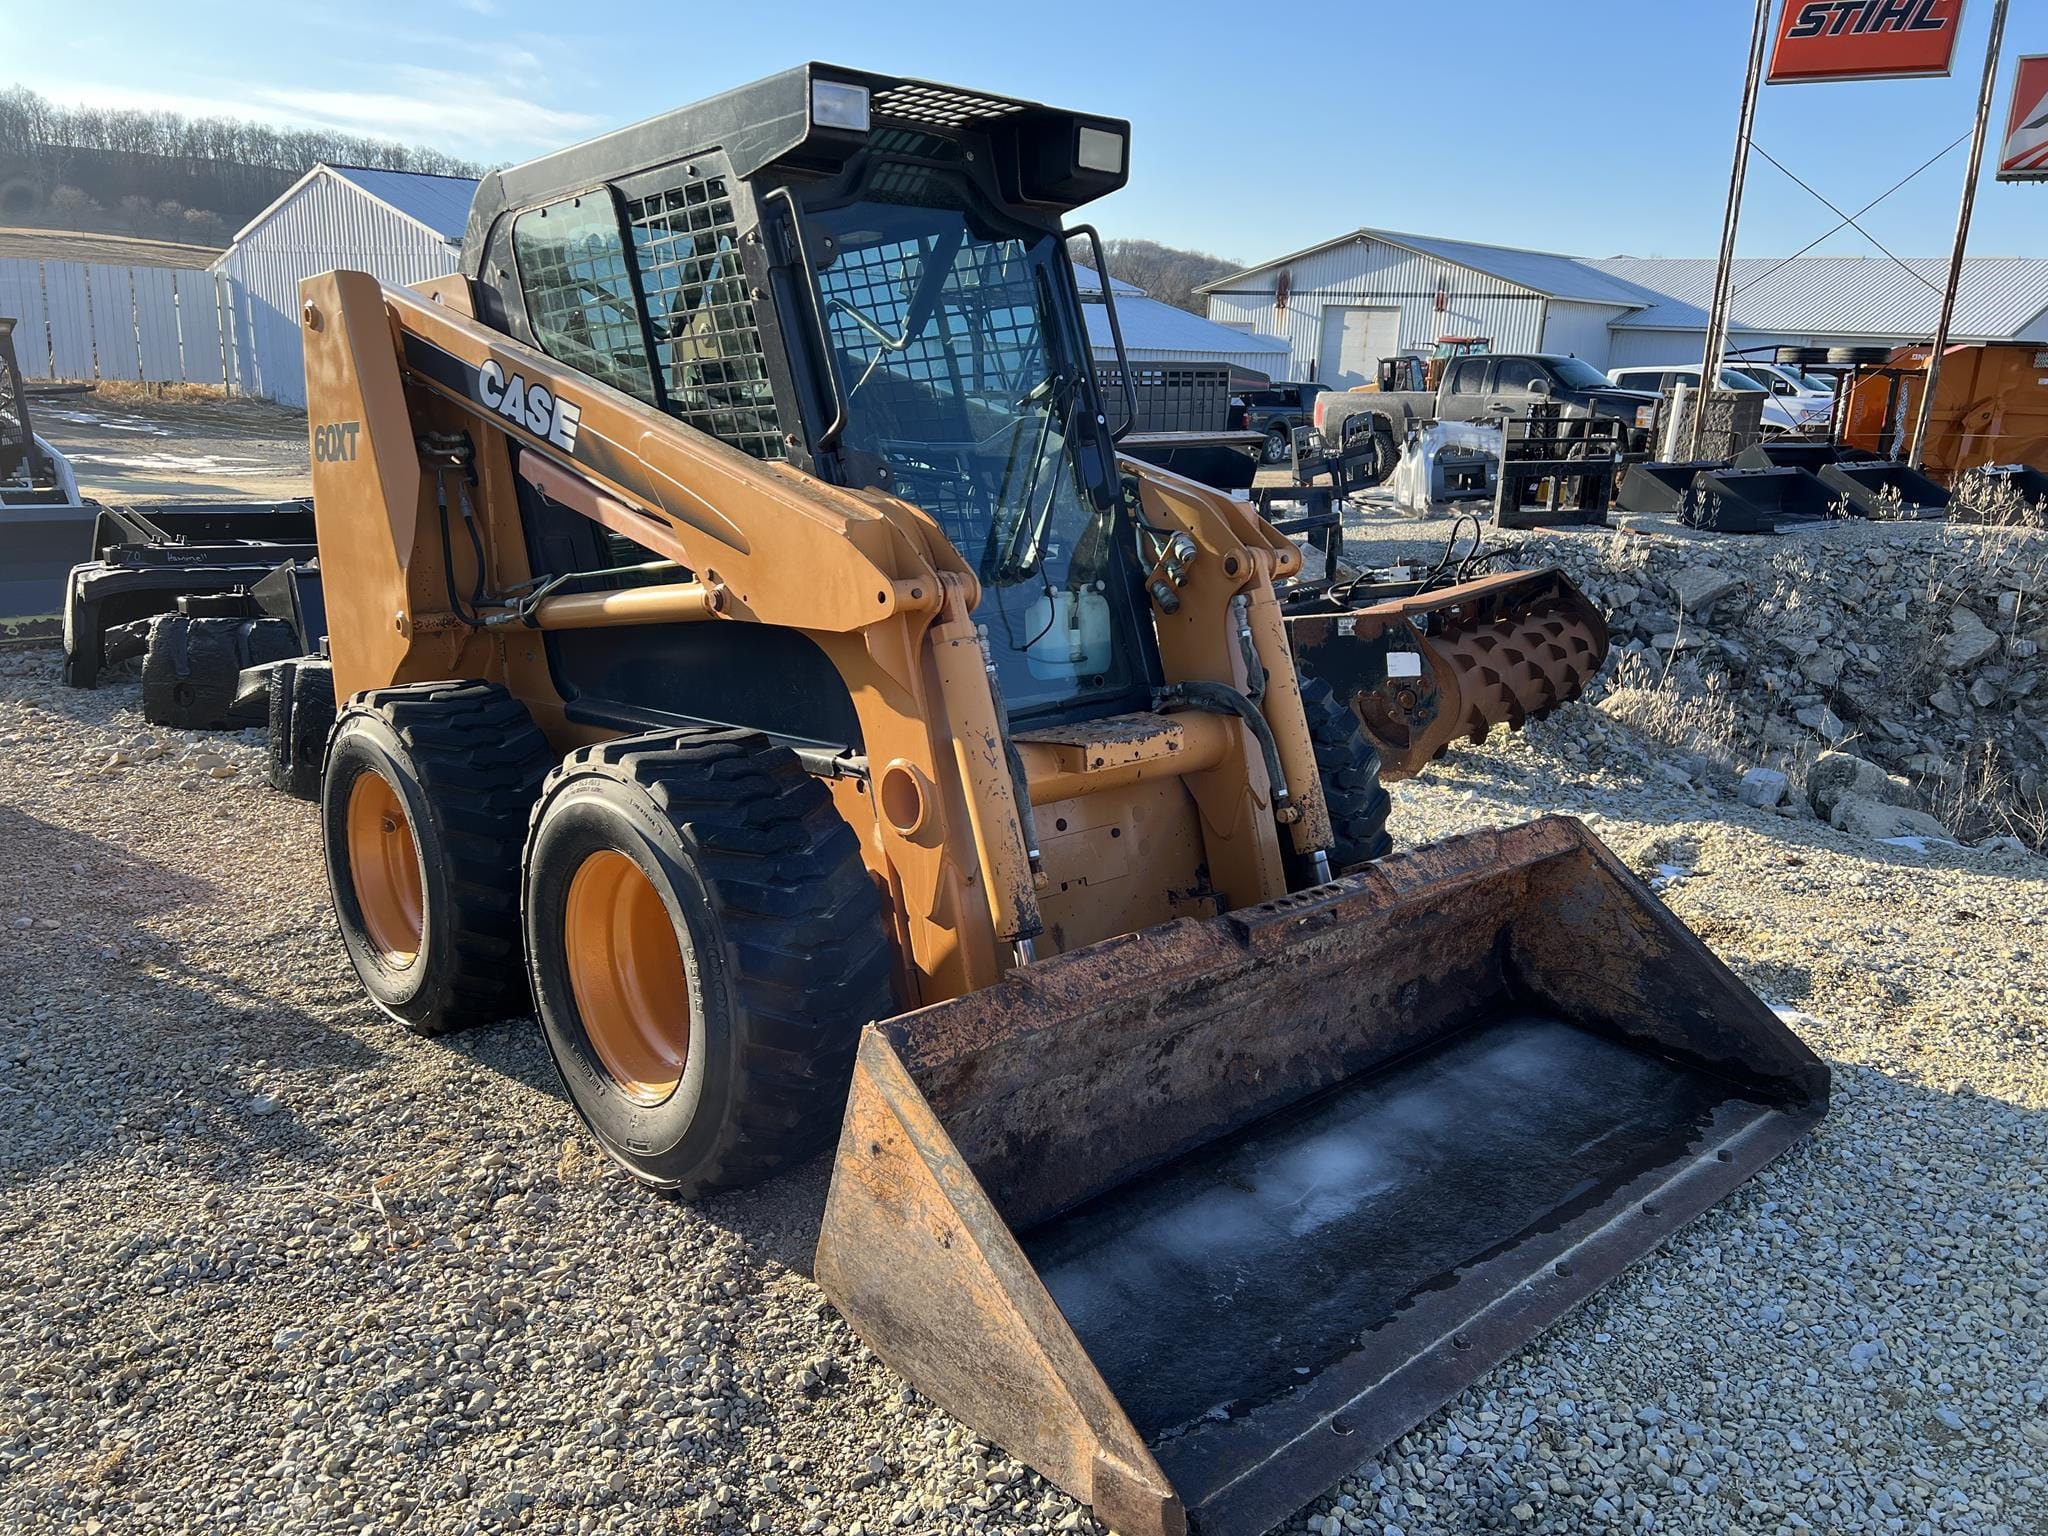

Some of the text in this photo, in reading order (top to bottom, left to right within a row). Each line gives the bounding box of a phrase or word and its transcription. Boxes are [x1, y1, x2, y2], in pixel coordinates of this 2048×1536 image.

[1785, 0, 1948, 39] STIHL
[479, 359, 581, 453] CASE
[315, 422, 360, 462] 60XT
